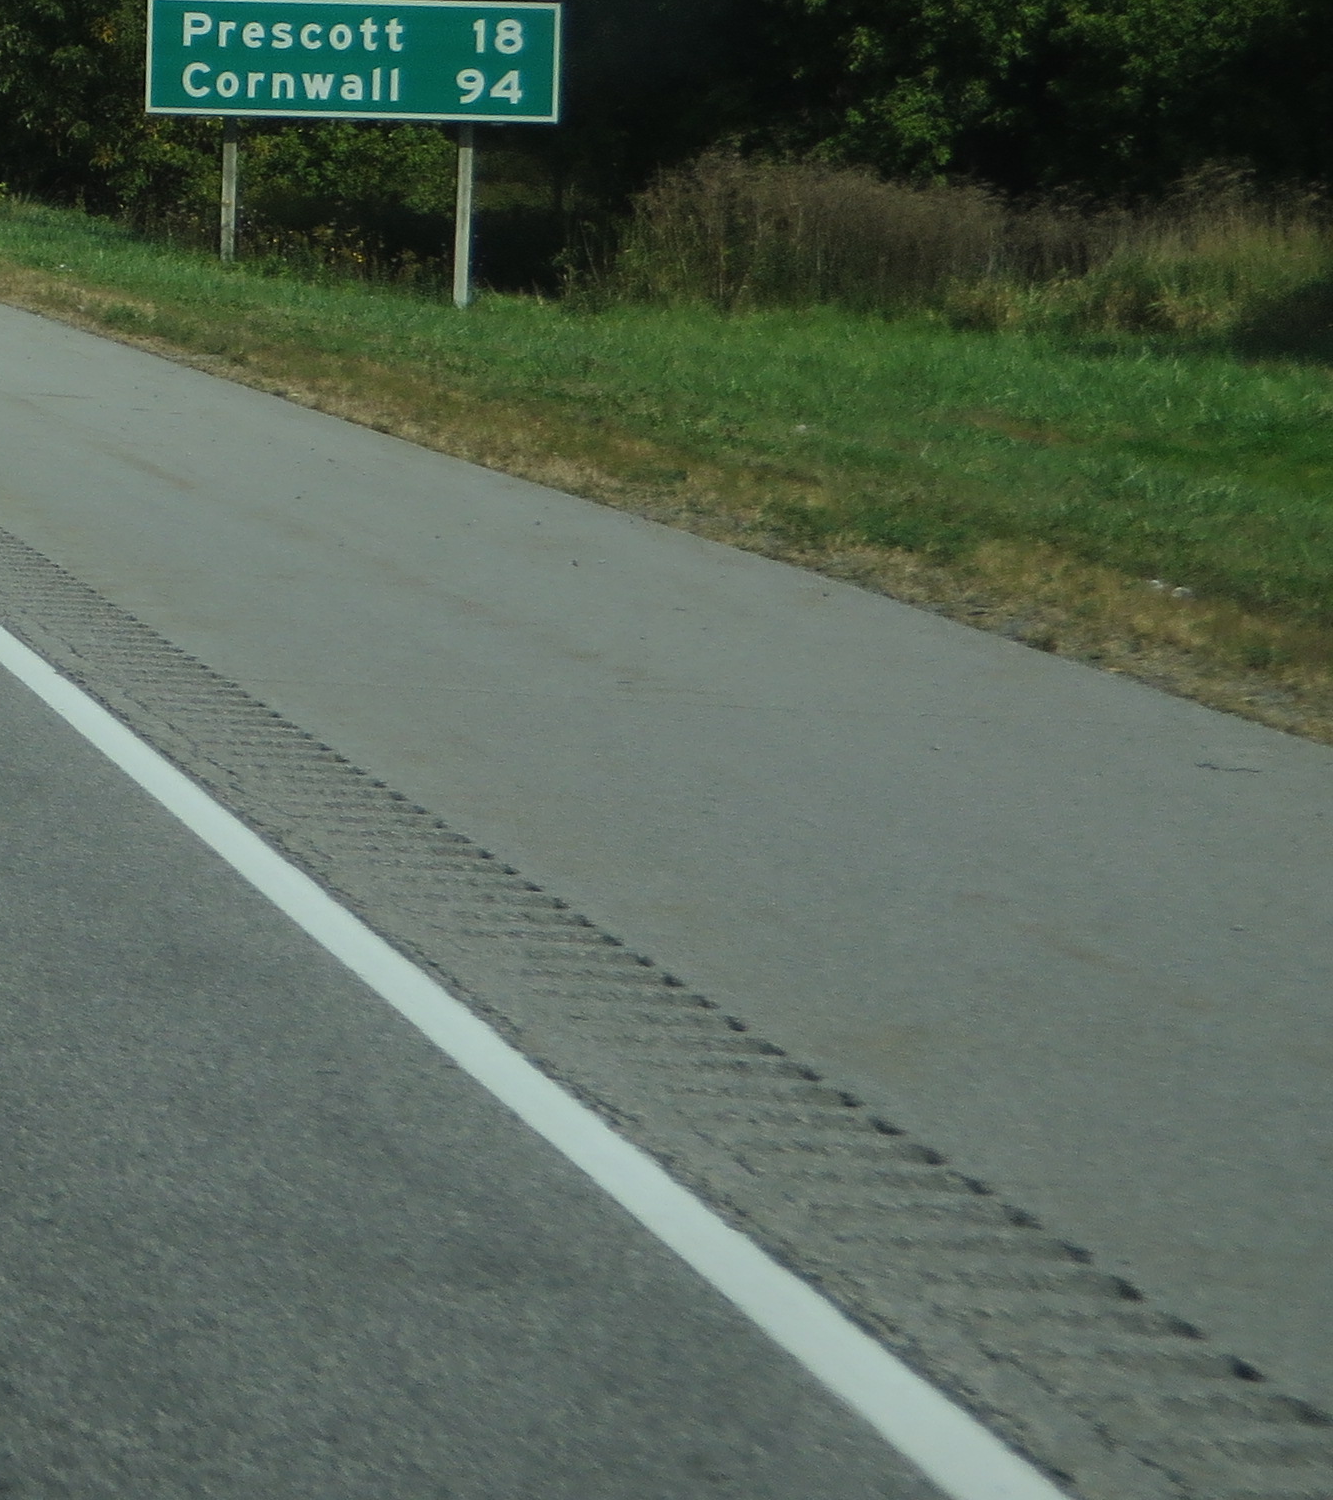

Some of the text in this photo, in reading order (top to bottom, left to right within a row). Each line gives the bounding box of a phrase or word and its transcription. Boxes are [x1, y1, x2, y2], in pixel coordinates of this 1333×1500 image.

[182, 11, 524, 55] Prescott 18
[182, 61, 524, 105] Cornwall 94
